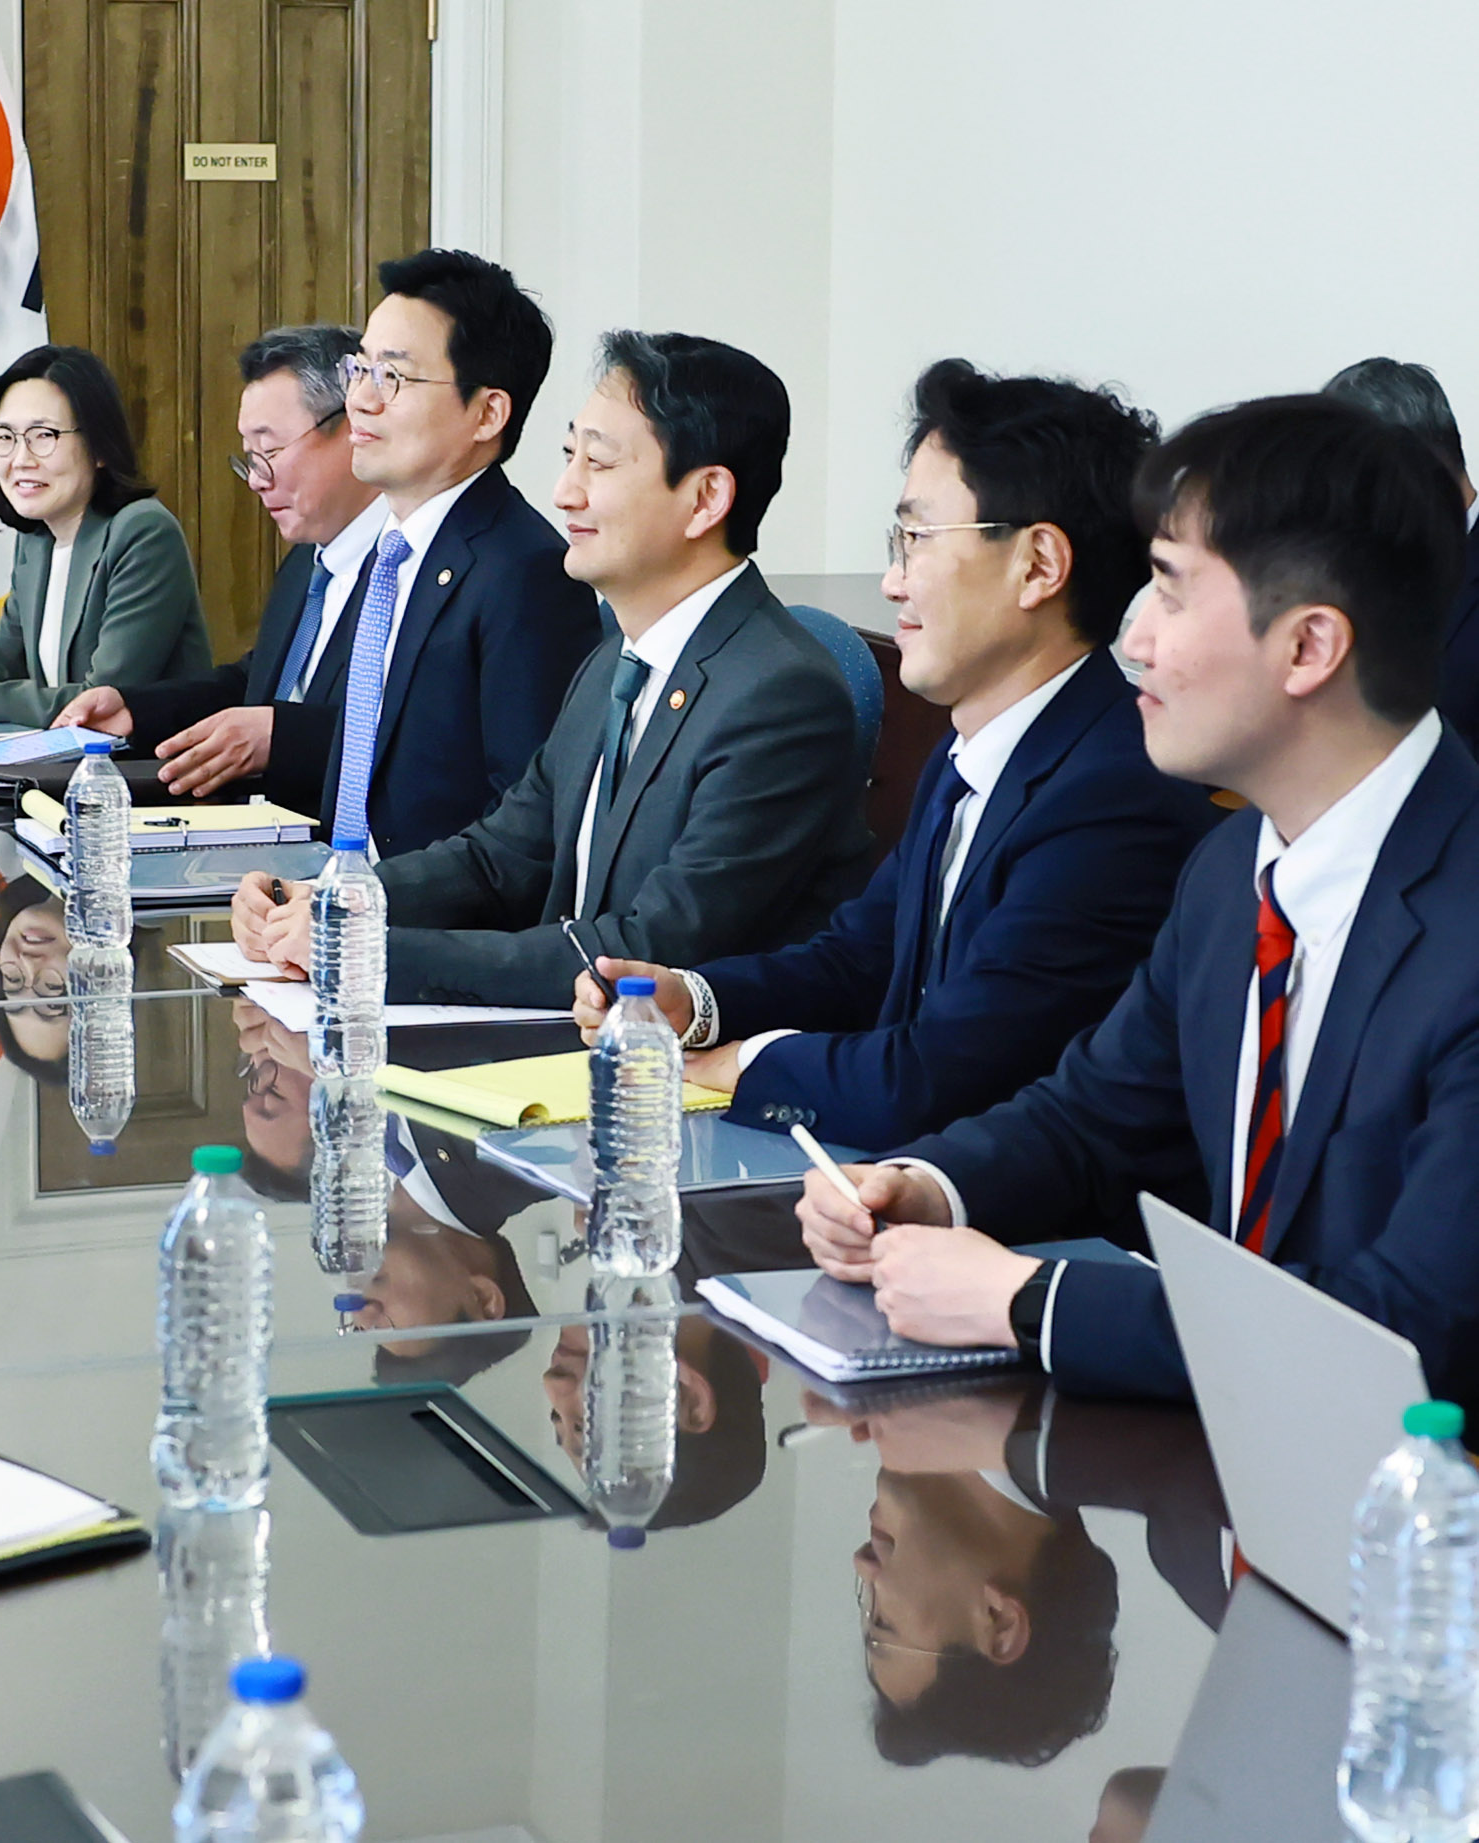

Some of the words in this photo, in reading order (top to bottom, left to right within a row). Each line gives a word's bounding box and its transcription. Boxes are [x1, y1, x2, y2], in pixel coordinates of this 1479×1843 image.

[192, 156, 208, 168] DO
[210, 156, 232, 168] NOT
[234, 156, 269, 168] ENTER
